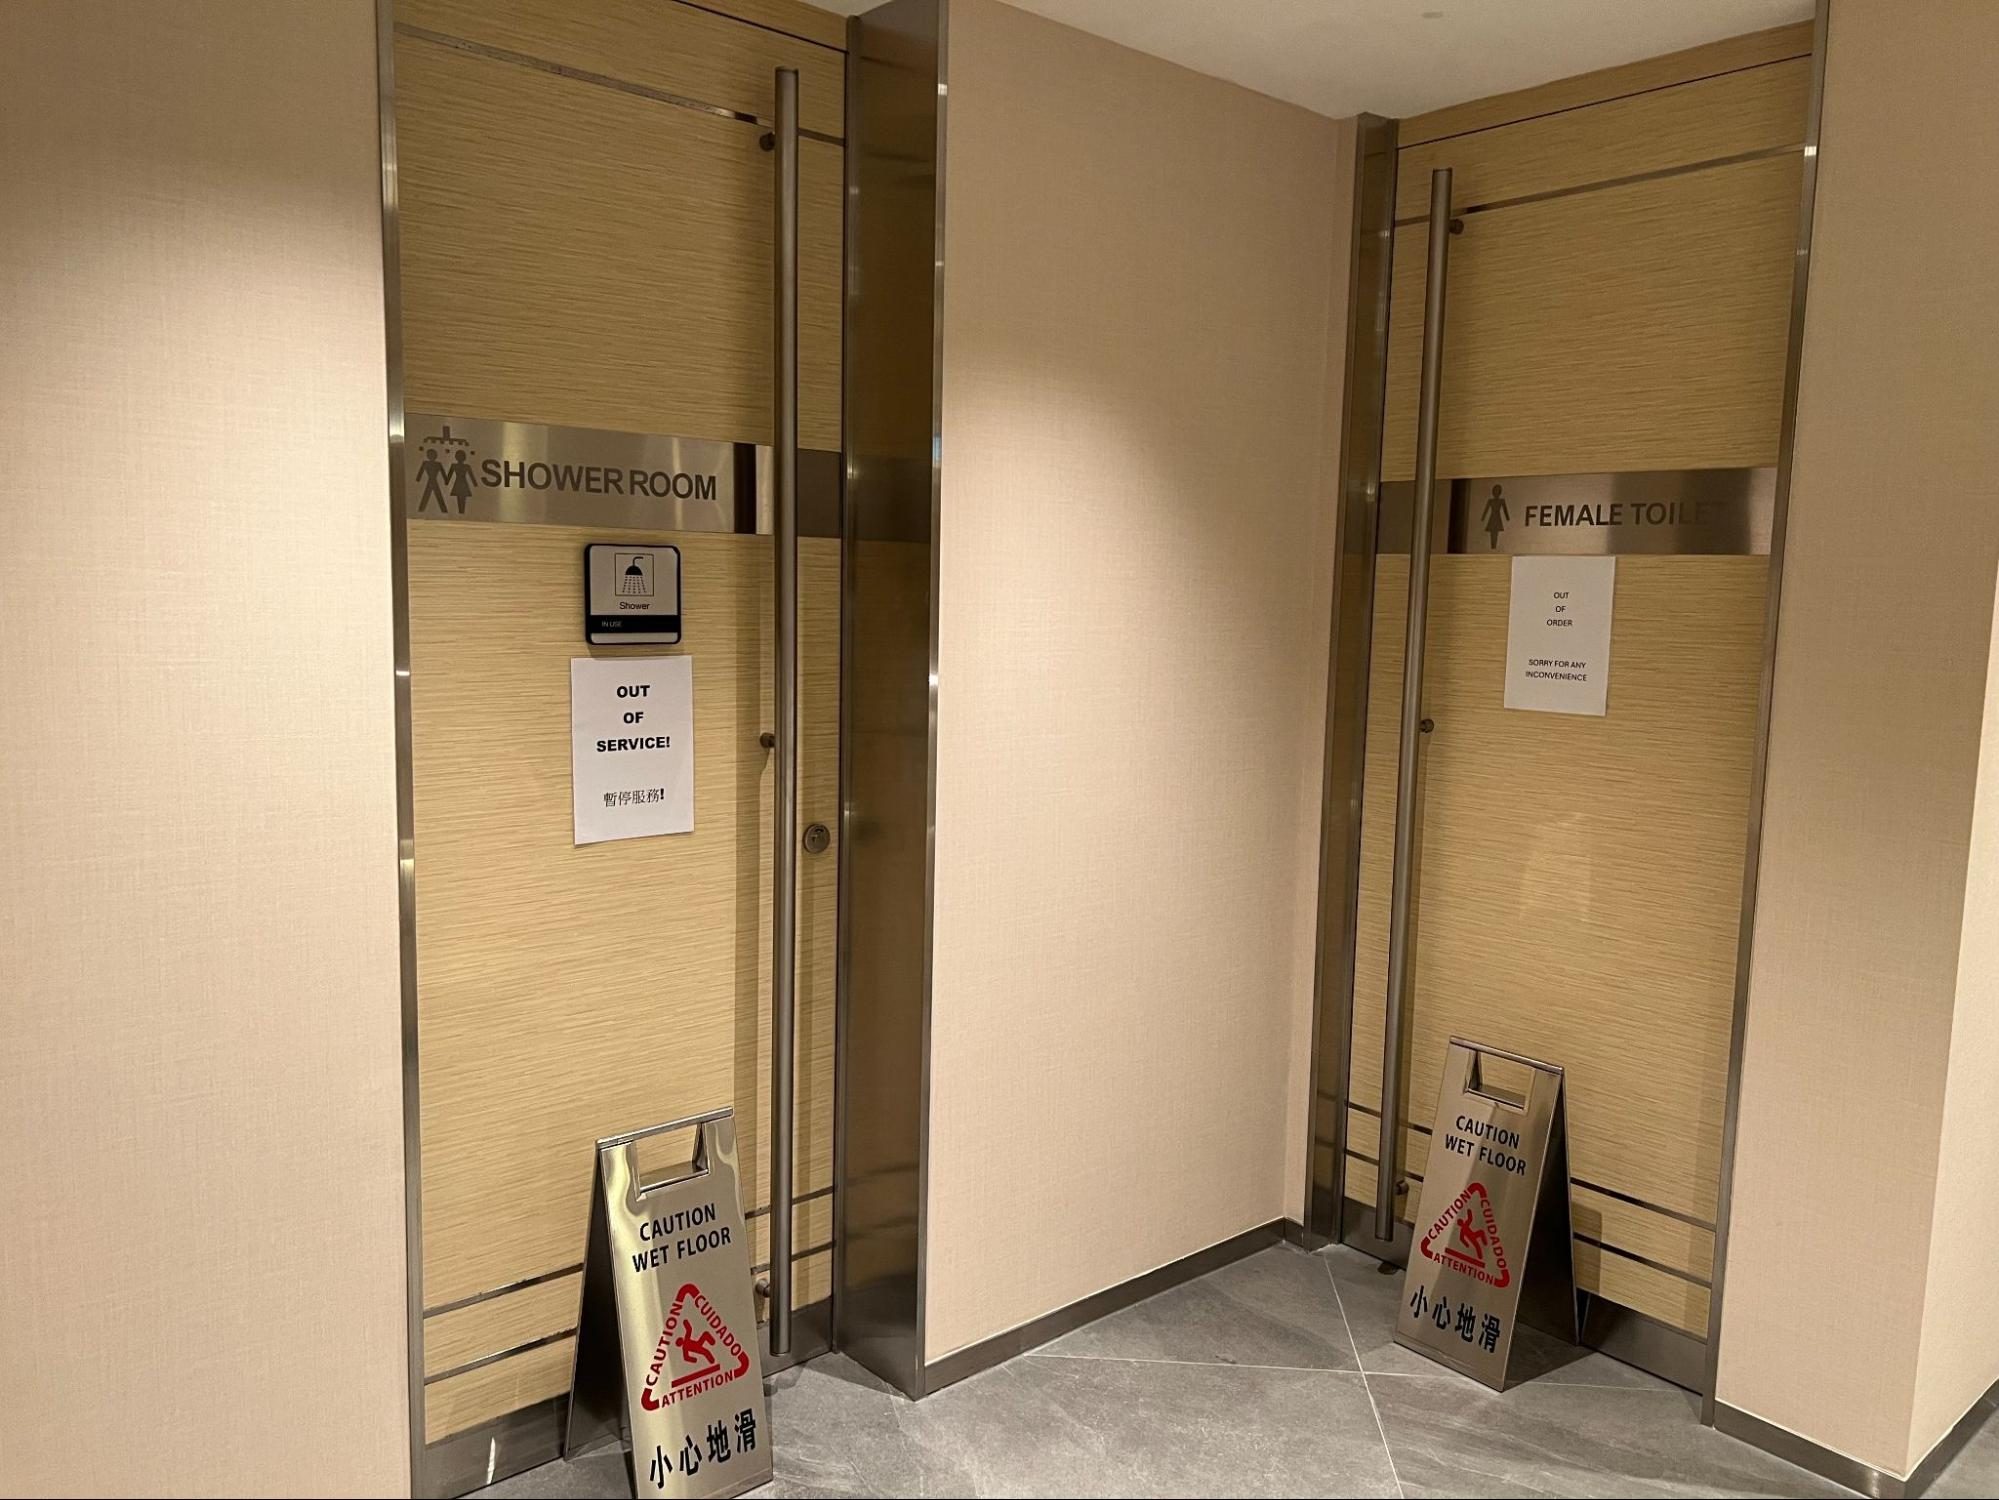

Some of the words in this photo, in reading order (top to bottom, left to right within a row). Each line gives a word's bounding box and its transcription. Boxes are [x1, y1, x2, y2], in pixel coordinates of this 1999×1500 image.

[480, 459, 626, 495] SHOWER
[628, 470, 718, 501] ROOM
[1524, 504, 1623, 527] FEMALE
[619, 601, 651, 610] Shower
[1553, 591, 1570, 600] OUT
[1555, 605, 1567, 613] OF
[601, 620, 609, 628] IN
[609, 620, 623, 628] USE
[1546, 618, 1573, 628] ORDER
[1525, 671, 1588, 682] INCONVENIENCE
[1528, 658, 1553, 668] SORRY
[1554, 660, 1569, 668] FOR
[1570, 661, 1587, 669] ANY
[616, 685, 651, 699] OUT
[622, 711, 644, 725] OF
[596, 736, 671, 753] SERVICE!
[603, 787, 665, 807] 暫停服務!
[1455, 1114, 1520, 1150] CAUTION
[1444, 1133, 1474, 1157] WET
[1478, 1146, 1527, 1176] FLOOR
[639, 1202, 717, 1242] CAUTION
[1428, 1189, 1471, 1240] CAUTION
[632, 1244, 669, 1273] WET
[676, 1226, 732, 1261] FLOOR
[1480, 1198, 1508, 1270] CUIDADO
[1433, 1252, 1496, 1286] ATTENTION
[693, 1294, 742, 1358] CUIDADO
[1409, 1284, 1501, 1354] 小心地滑
[646, 1299, 684, 1387] CAUTION
[661, 1368, 734, 1409] ATTENTION
[649, 1407, 757, 1489] 小心地滑
